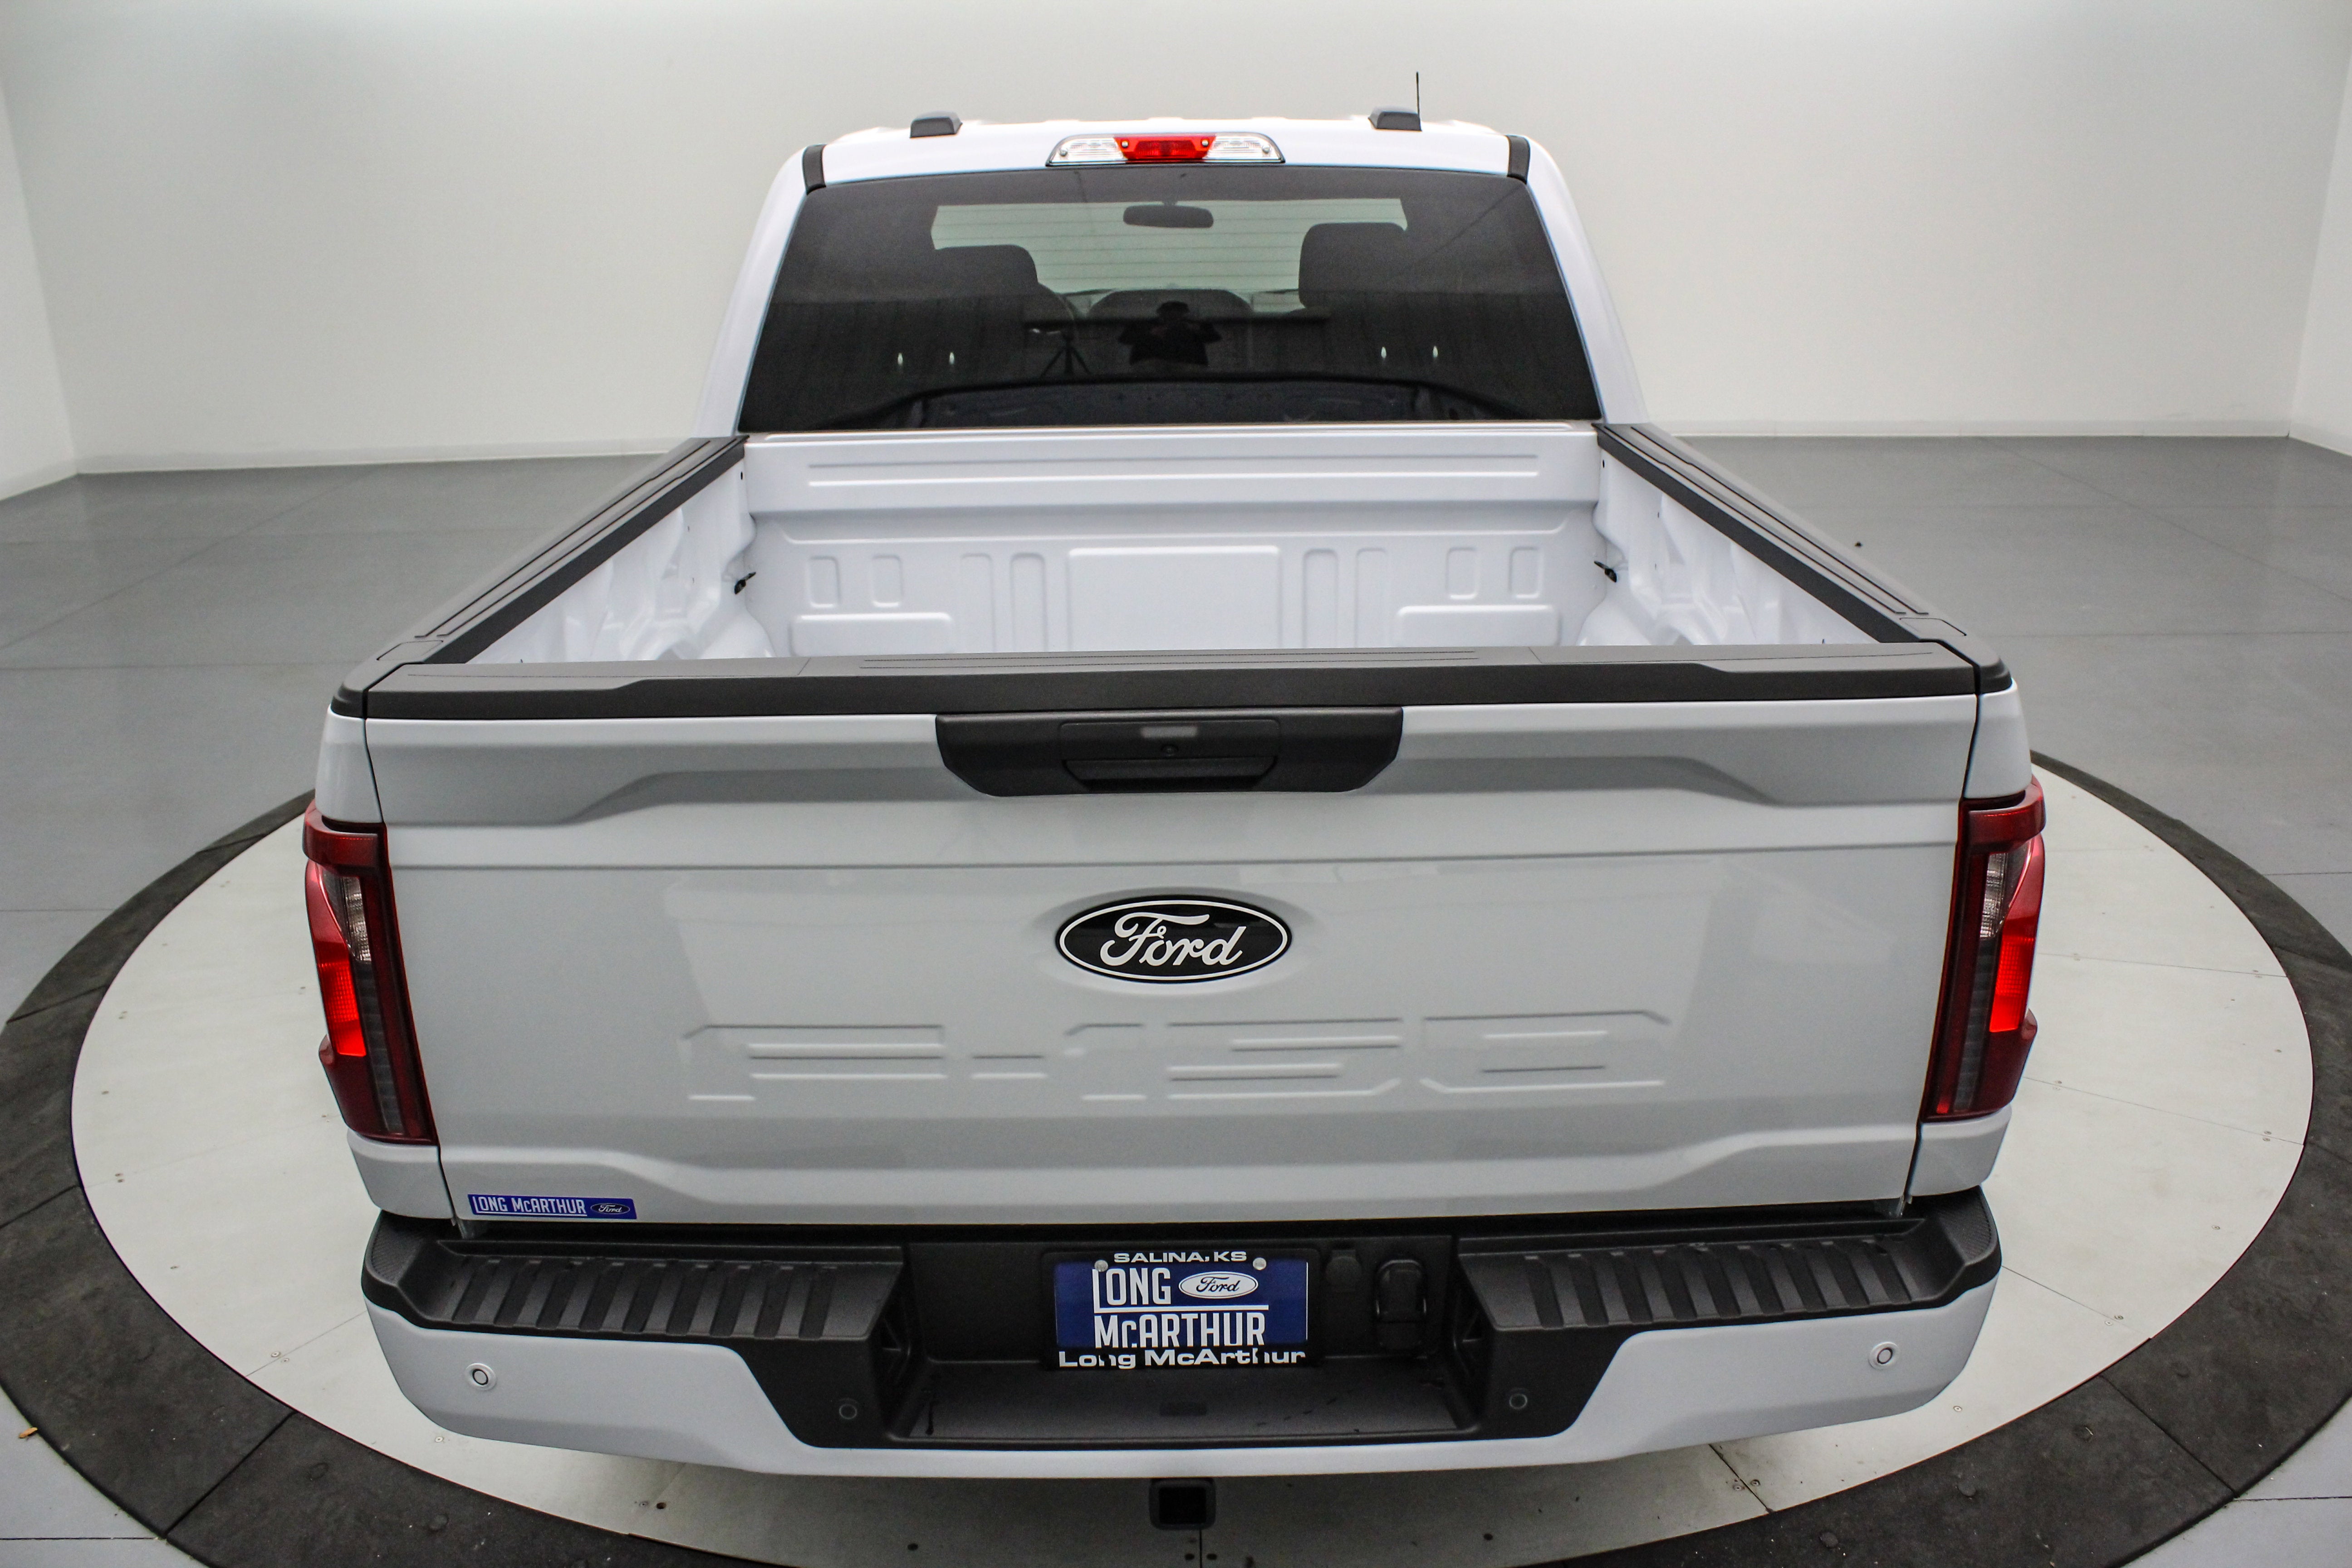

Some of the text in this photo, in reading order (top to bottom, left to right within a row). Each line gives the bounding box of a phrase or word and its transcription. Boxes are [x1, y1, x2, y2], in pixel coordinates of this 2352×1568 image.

[1100, 911, 1247, 966] Ford
[473, 1196, 622, 1214] LONG McARTHUR Ford
[1113, 1251, 1247, 1264] SALINA, KS
[1092, 1267, 1241, 1313] LONG Ford
[1094, 1311, 1266, 1349] McARTHUR
[1058, 1351, 1136, 1369] Long
